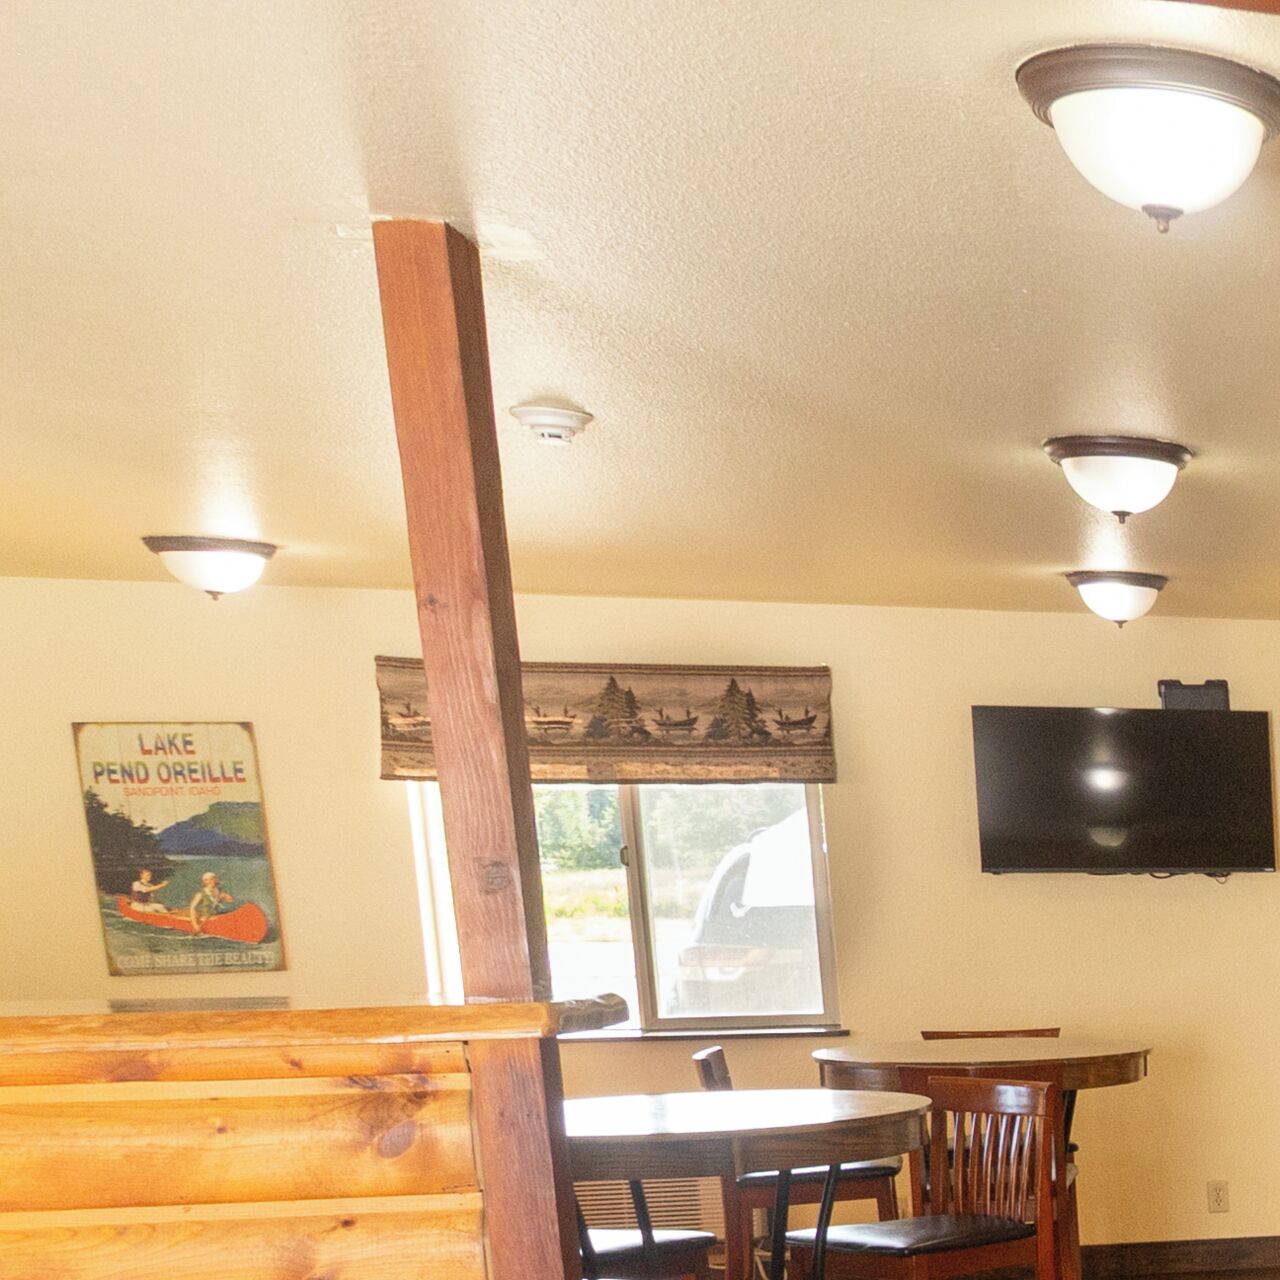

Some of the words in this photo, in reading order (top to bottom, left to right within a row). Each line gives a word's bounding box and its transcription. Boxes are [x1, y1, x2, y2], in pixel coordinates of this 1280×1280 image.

[138, 732, 196, 756] LAKE
[93, 761, 149, 785] PEND
[157, 761, 247, 785] OREILLE
[117, 956, 154, 969] COME
[155, 954, 196, 968] SHARE
[197, 953, 223, 966] THE
